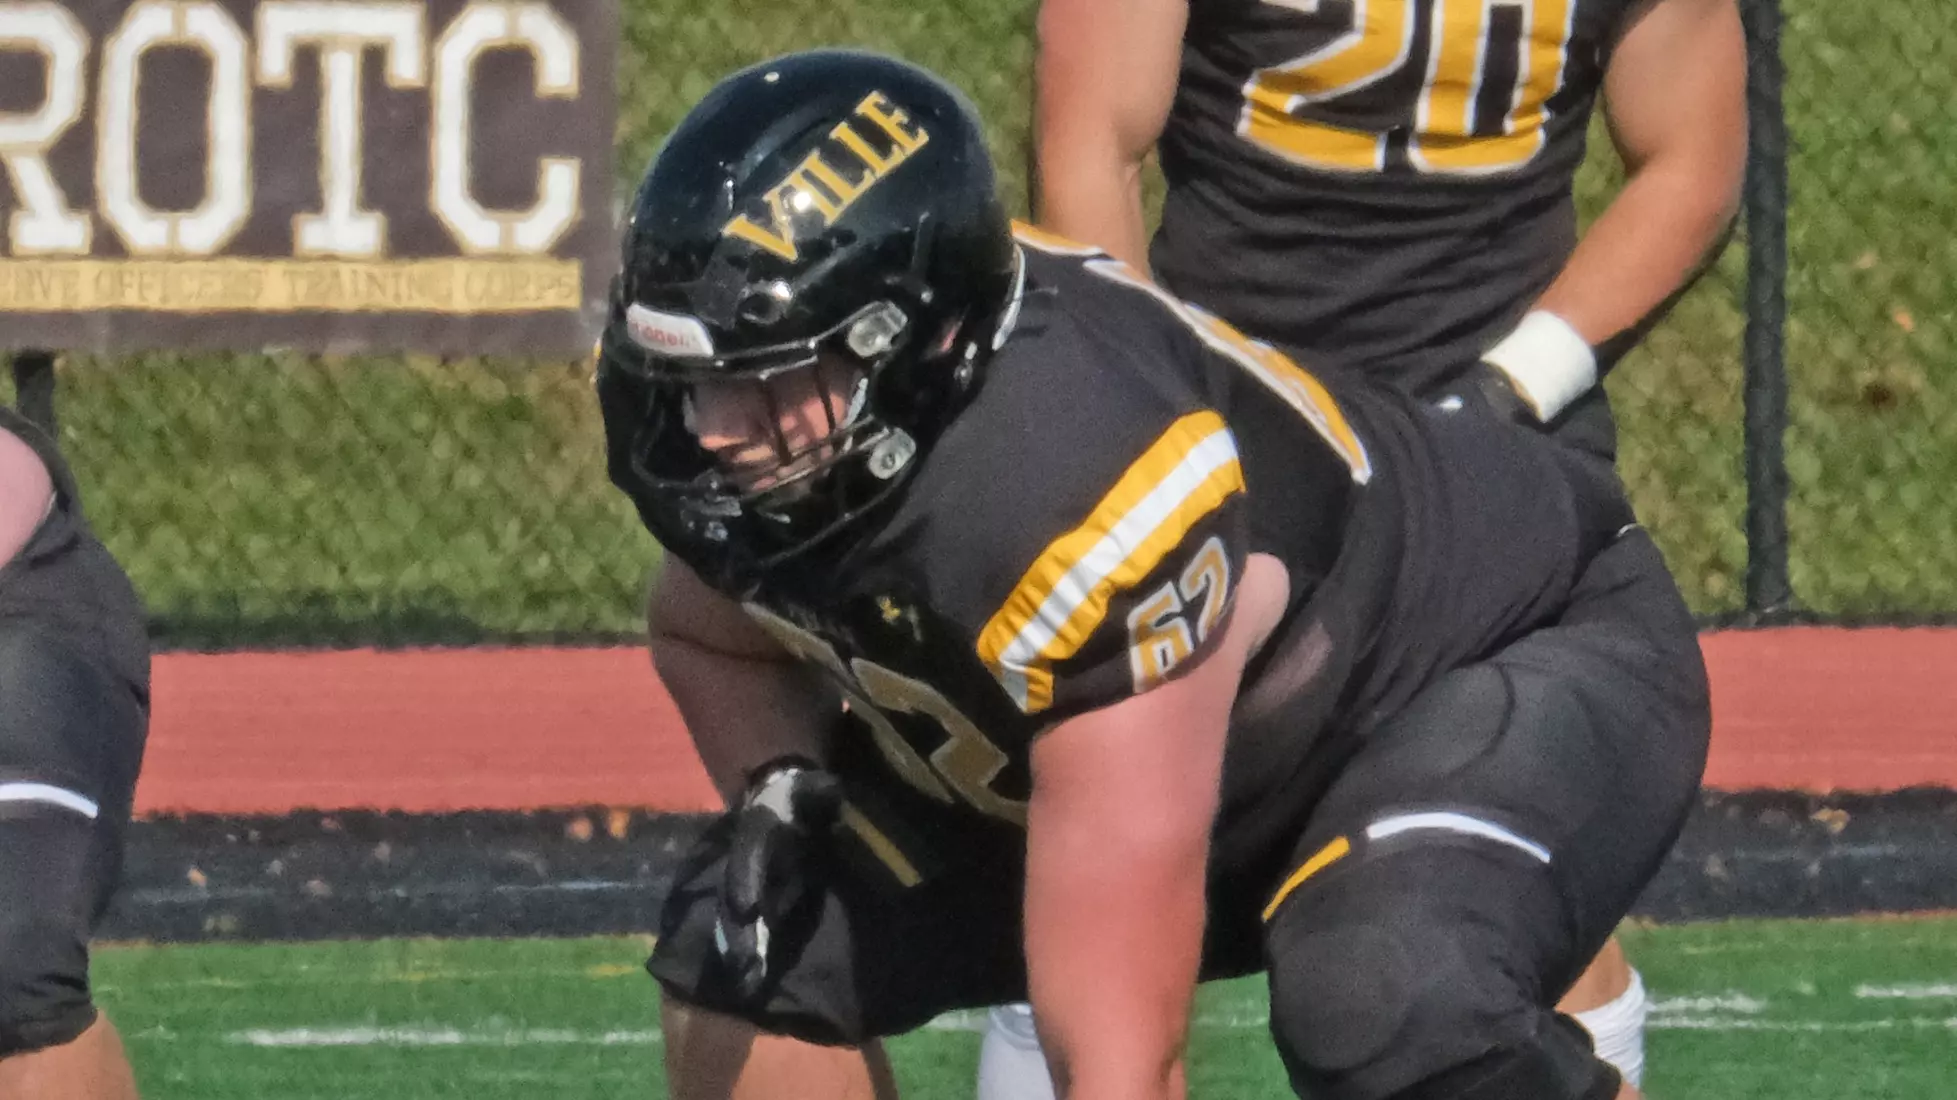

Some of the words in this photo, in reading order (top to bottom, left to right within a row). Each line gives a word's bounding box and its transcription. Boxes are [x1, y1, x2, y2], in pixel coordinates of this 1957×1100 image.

[0, 0, 582, 256] ROTC
[1236, 0, 1575, 174] 20
[721, 89, 929, 264] VILLE
[1127, 536, 1230, 694] 62
